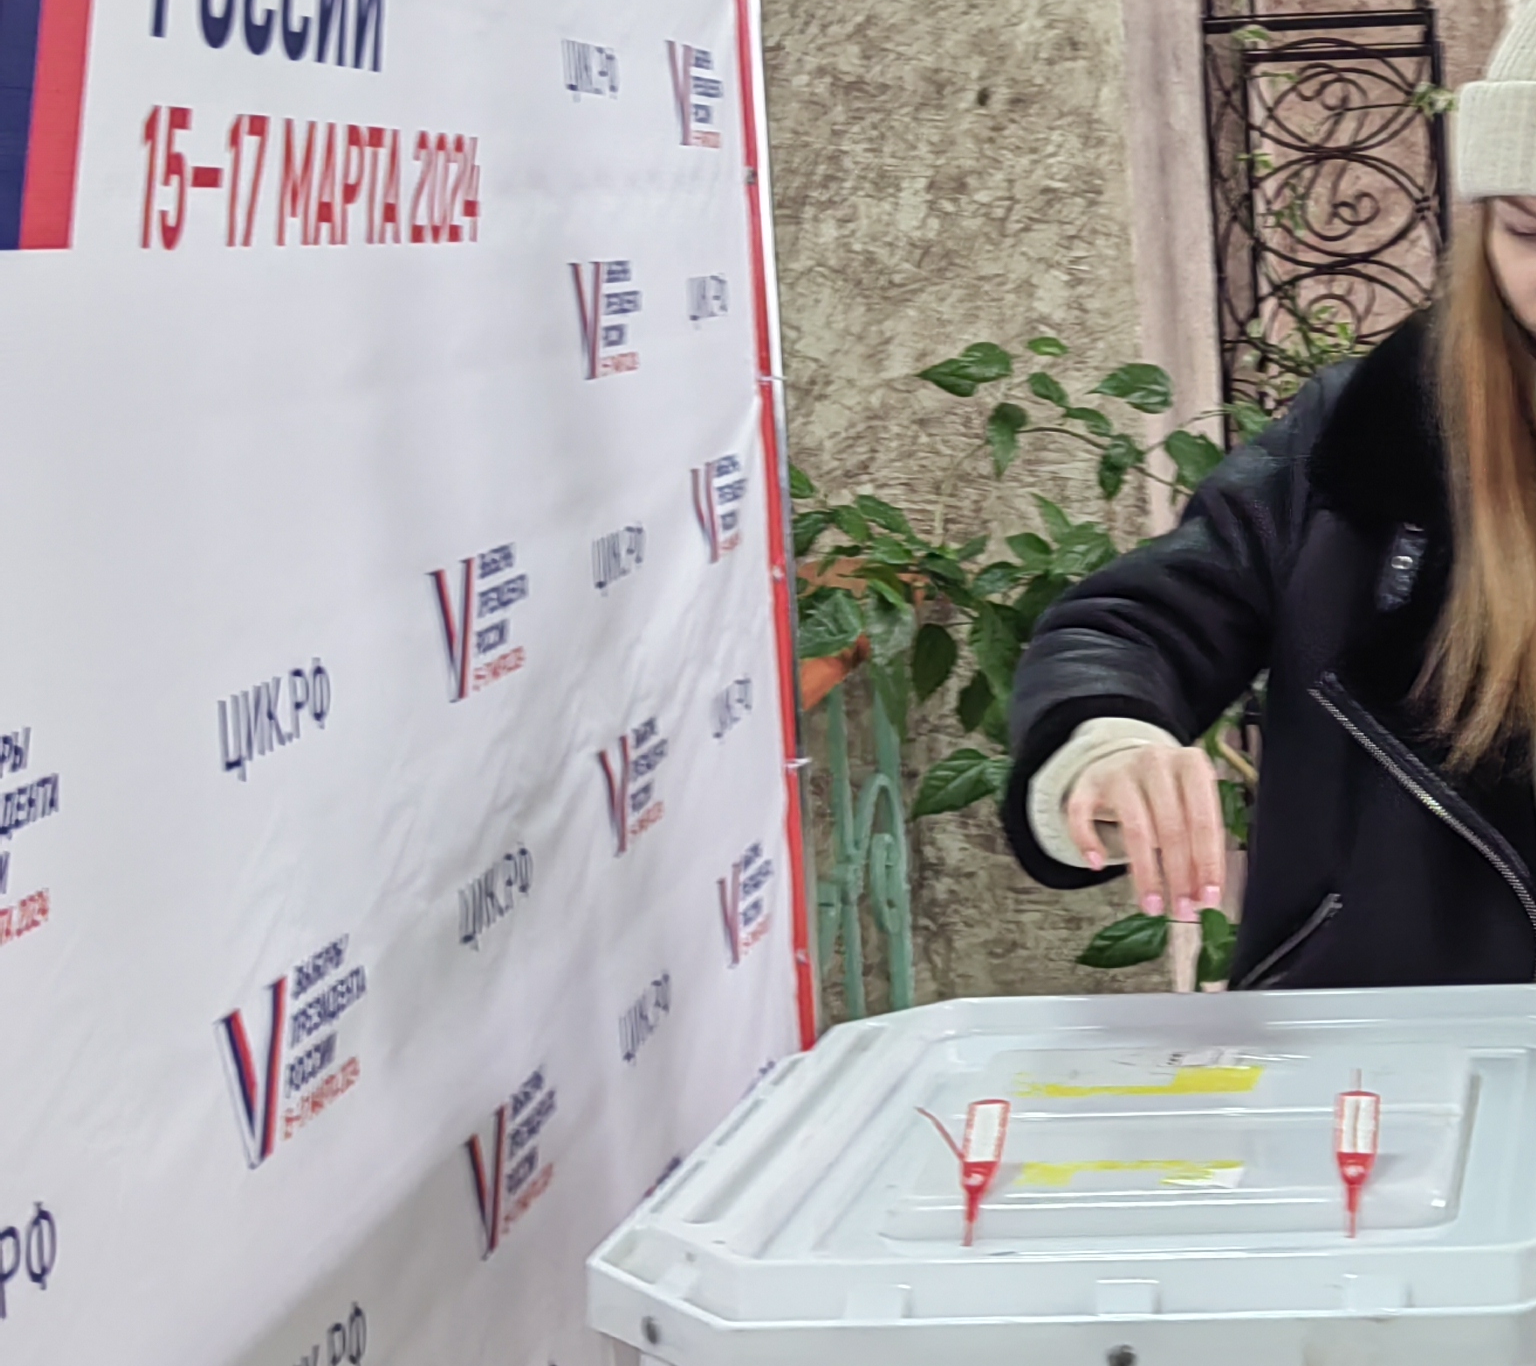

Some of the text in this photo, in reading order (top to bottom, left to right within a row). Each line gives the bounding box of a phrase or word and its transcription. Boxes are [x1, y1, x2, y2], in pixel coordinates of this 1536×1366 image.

[275, 117, 401, 247] МАРТА
[410, 130, 480, 244] 2024
[217, 656, 331, 782] ЦИК.РФ
